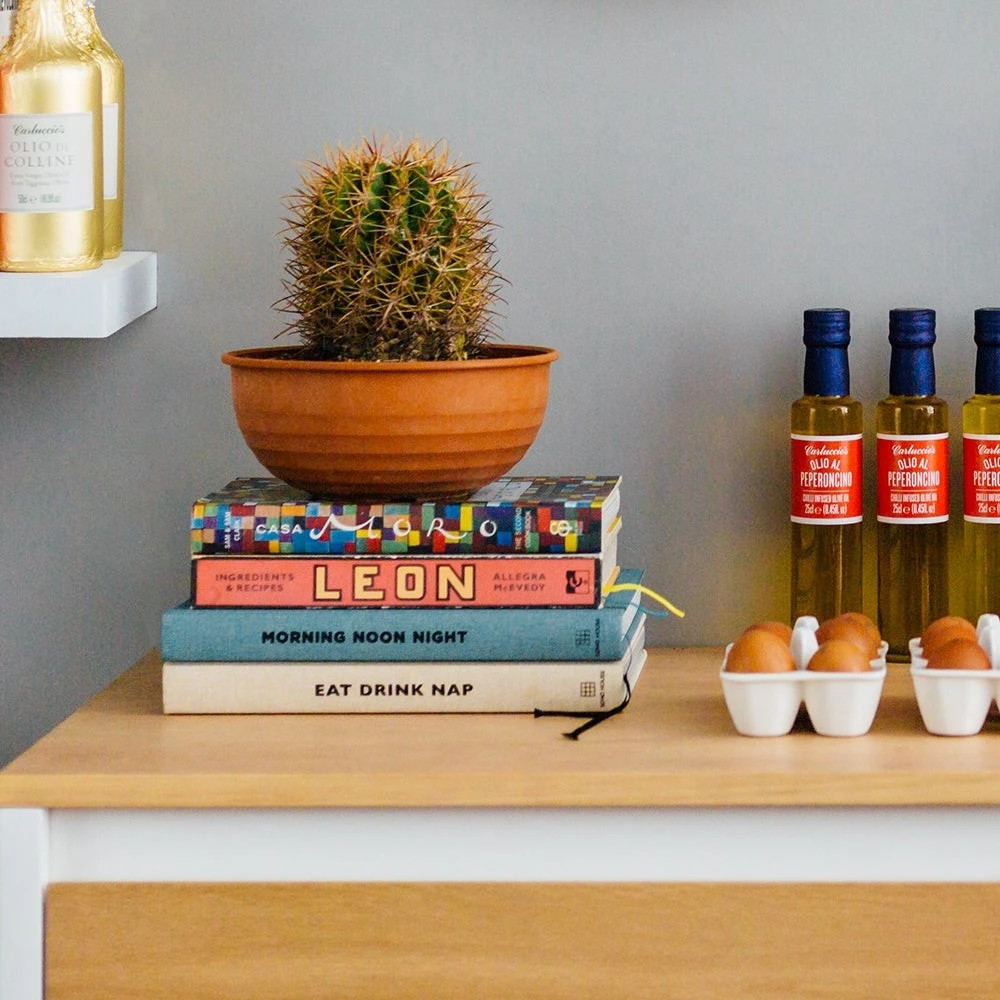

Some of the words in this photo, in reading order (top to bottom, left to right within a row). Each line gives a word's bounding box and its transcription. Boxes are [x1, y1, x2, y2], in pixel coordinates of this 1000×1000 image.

[10, 141, 51, 153] OLIO
[4, 155, 76, 167] COLLINE
[804, 445, 849, 456] Carluccio's
[892, 444, 936, 455] Carluccio's
[810, 458, 828, 471] OLIO
[831, 459, 841, 471] AL
[898, 457, 917, 470] OLIO
[919, 458, 929, 470] AL
[800, 471, 853, 488] PEPERONCINO
[888, 471, 941, 487] PEPERONCINO
[255, 523, 303, 534] CASA
[215, 573, 295, 582] INGREDIENTS
[313, 564, 476, 602] LEON
[493, 573, 546, 582] ALLEGRA
[226, 584, 233, 592] &
[236, 584, 284, 592] RECIPES
[261, 631, 346, 645] MORNING
[352, 631, 406, 644] NOON
[412, 631, 468, 644] NIGHT
[314, 683, 351, 697] EAT
[360, 683, 424, 697] DRINK
[432, 683, 474, 697] NAP
